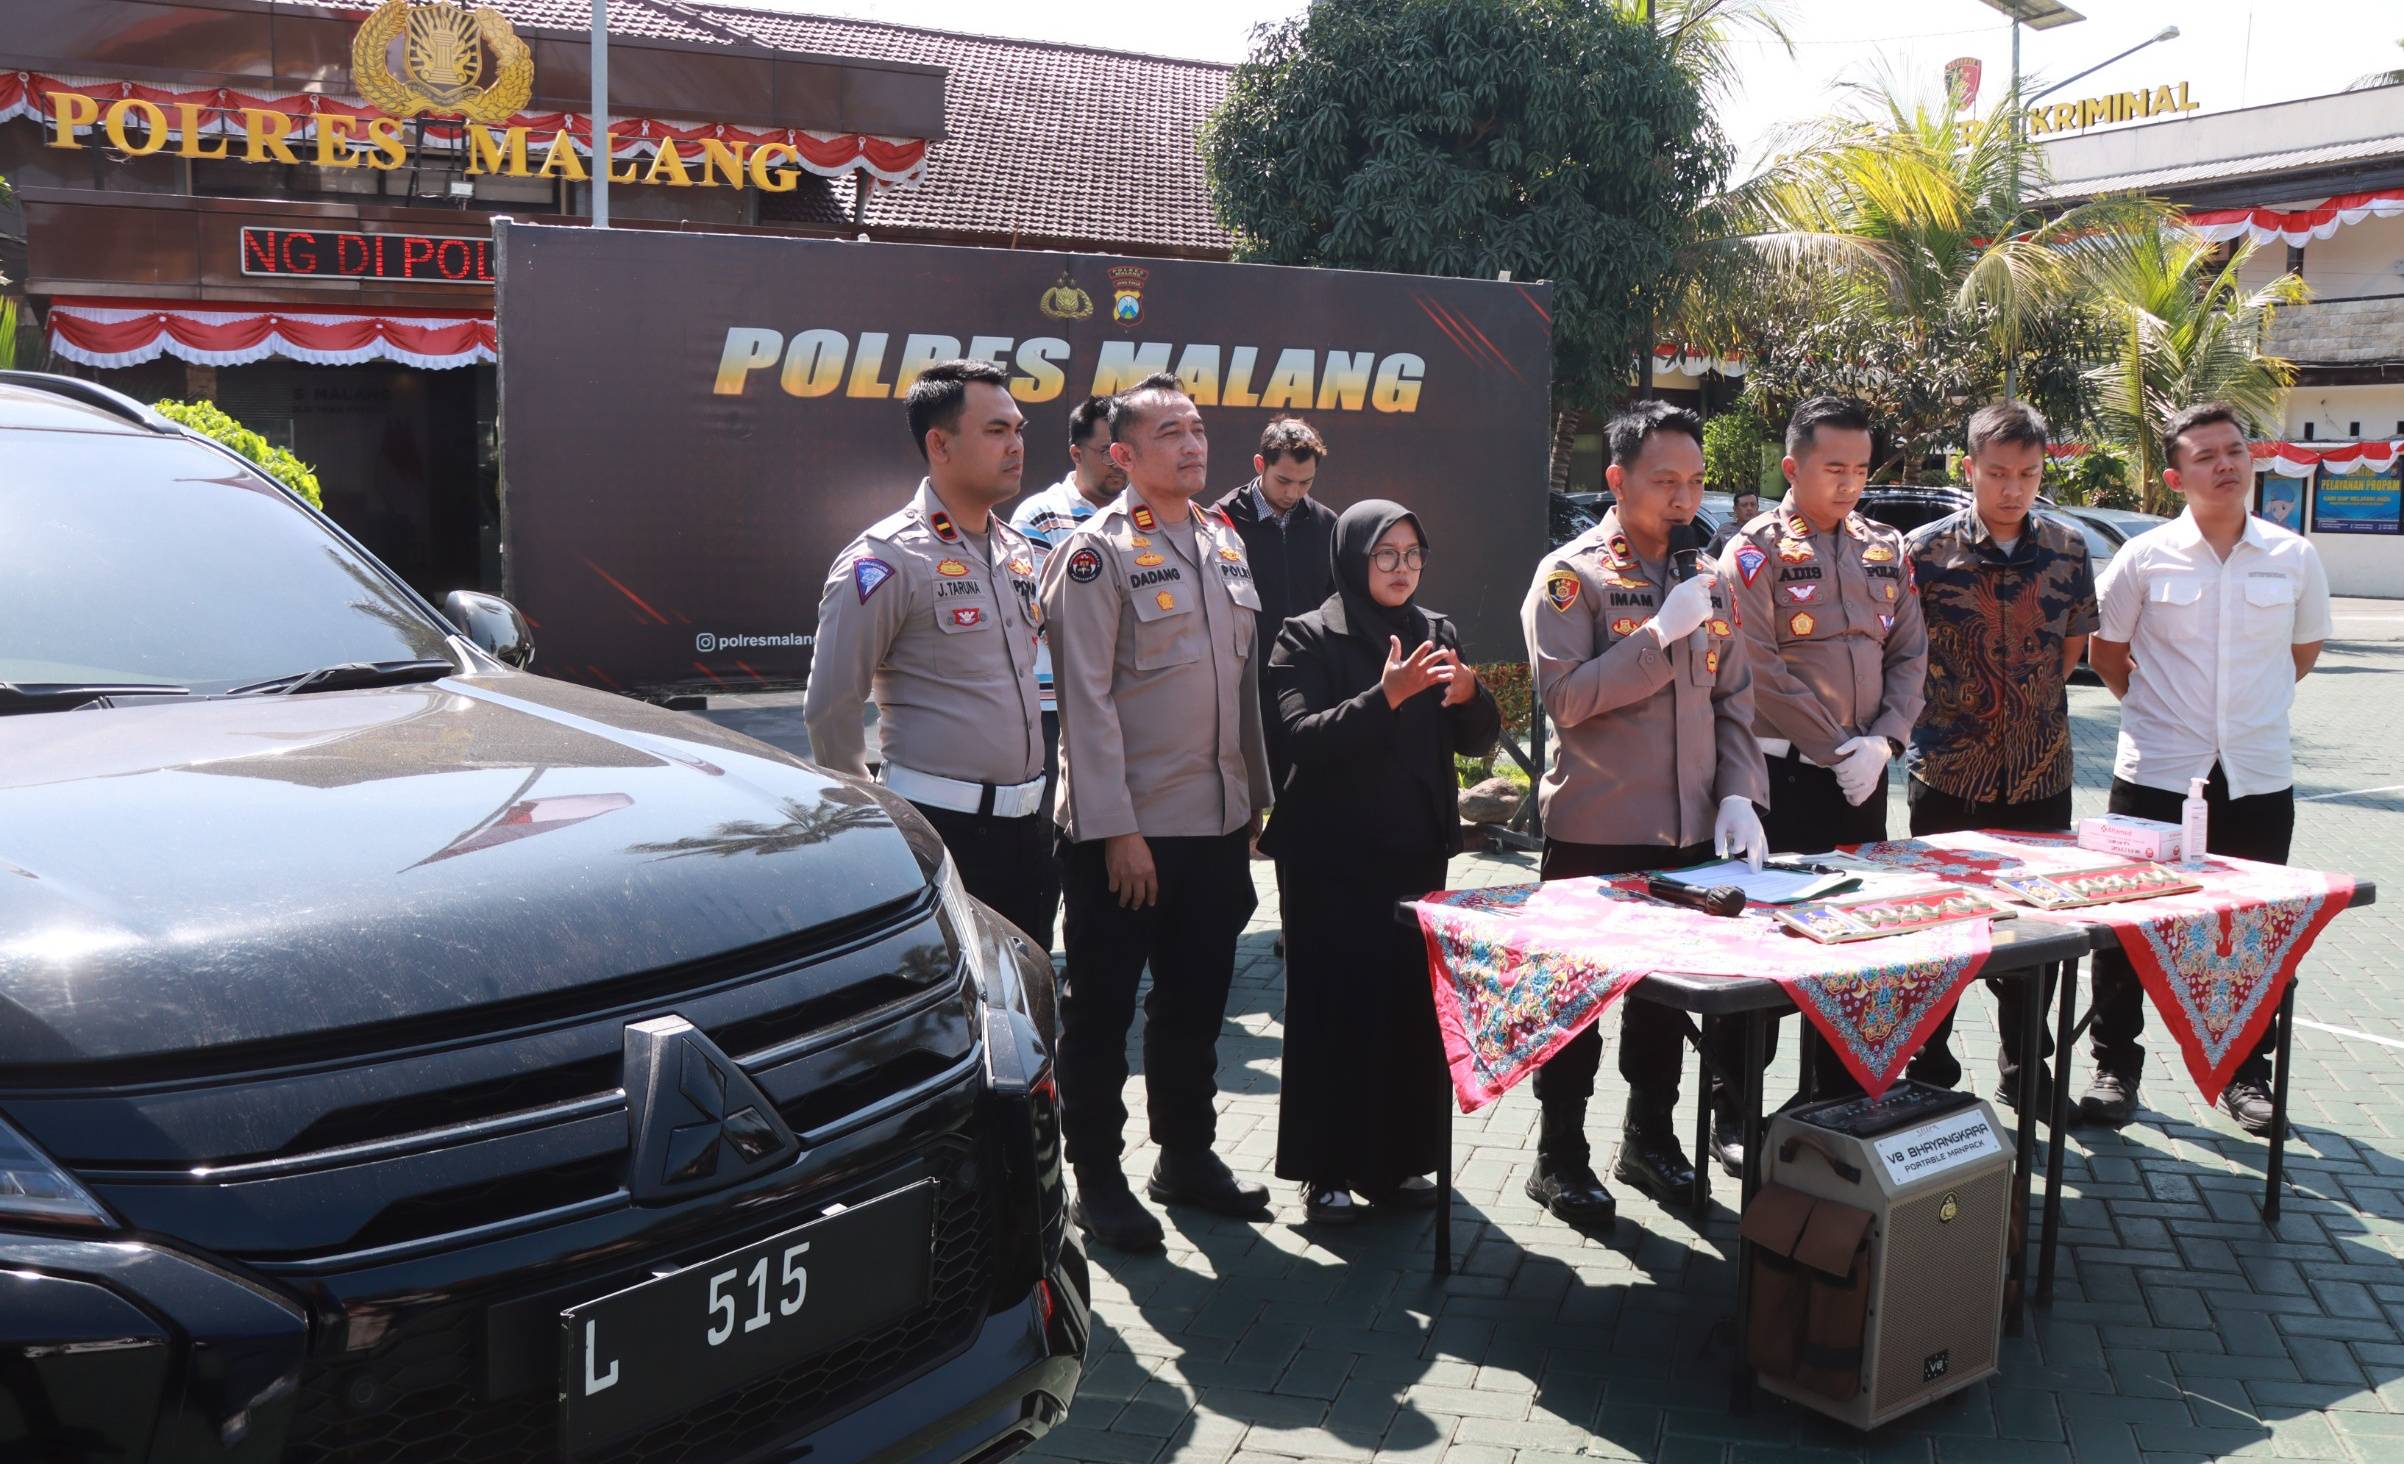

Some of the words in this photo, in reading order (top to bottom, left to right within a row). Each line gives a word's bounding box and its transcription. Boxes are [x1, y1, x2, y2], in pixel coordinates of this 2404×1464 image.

[2030, 81, 2200, 136] KRIMINAL
[46, 91, 407, 171] POLRES
[464, 123, 802, 192] MALANG
[245, 230, 317, 273] NG
[338, 235, 383, 276] DI
[1091, 340, 1426, 413] MALANG
[2321, 479, 2364, 491] PELAYANAN
[2366, 479, 2400, 491] PROPAM
[1130, 567, 1181, 589] DADANG
[1222, 564, 1250, 581] POLRI
[1779, 566, 1823, 582] ADIS
[1610, 592, 1654, 607] IMAM
[719, 632, 817, 651] polresmalan
[1887, 1151, 1905, 1164] V8
[1907, 1123, 1989, 1158] BHAYANGKARA
[1904, 1153, 1947, 1173] PORTABLE
[1947, 1140, 1985, 1159] MANPACK
[585, 1319, 619, 1396] L
[707, 1241, 810, 1347] 515
[1930, 1359, 1944, 1372] V8
